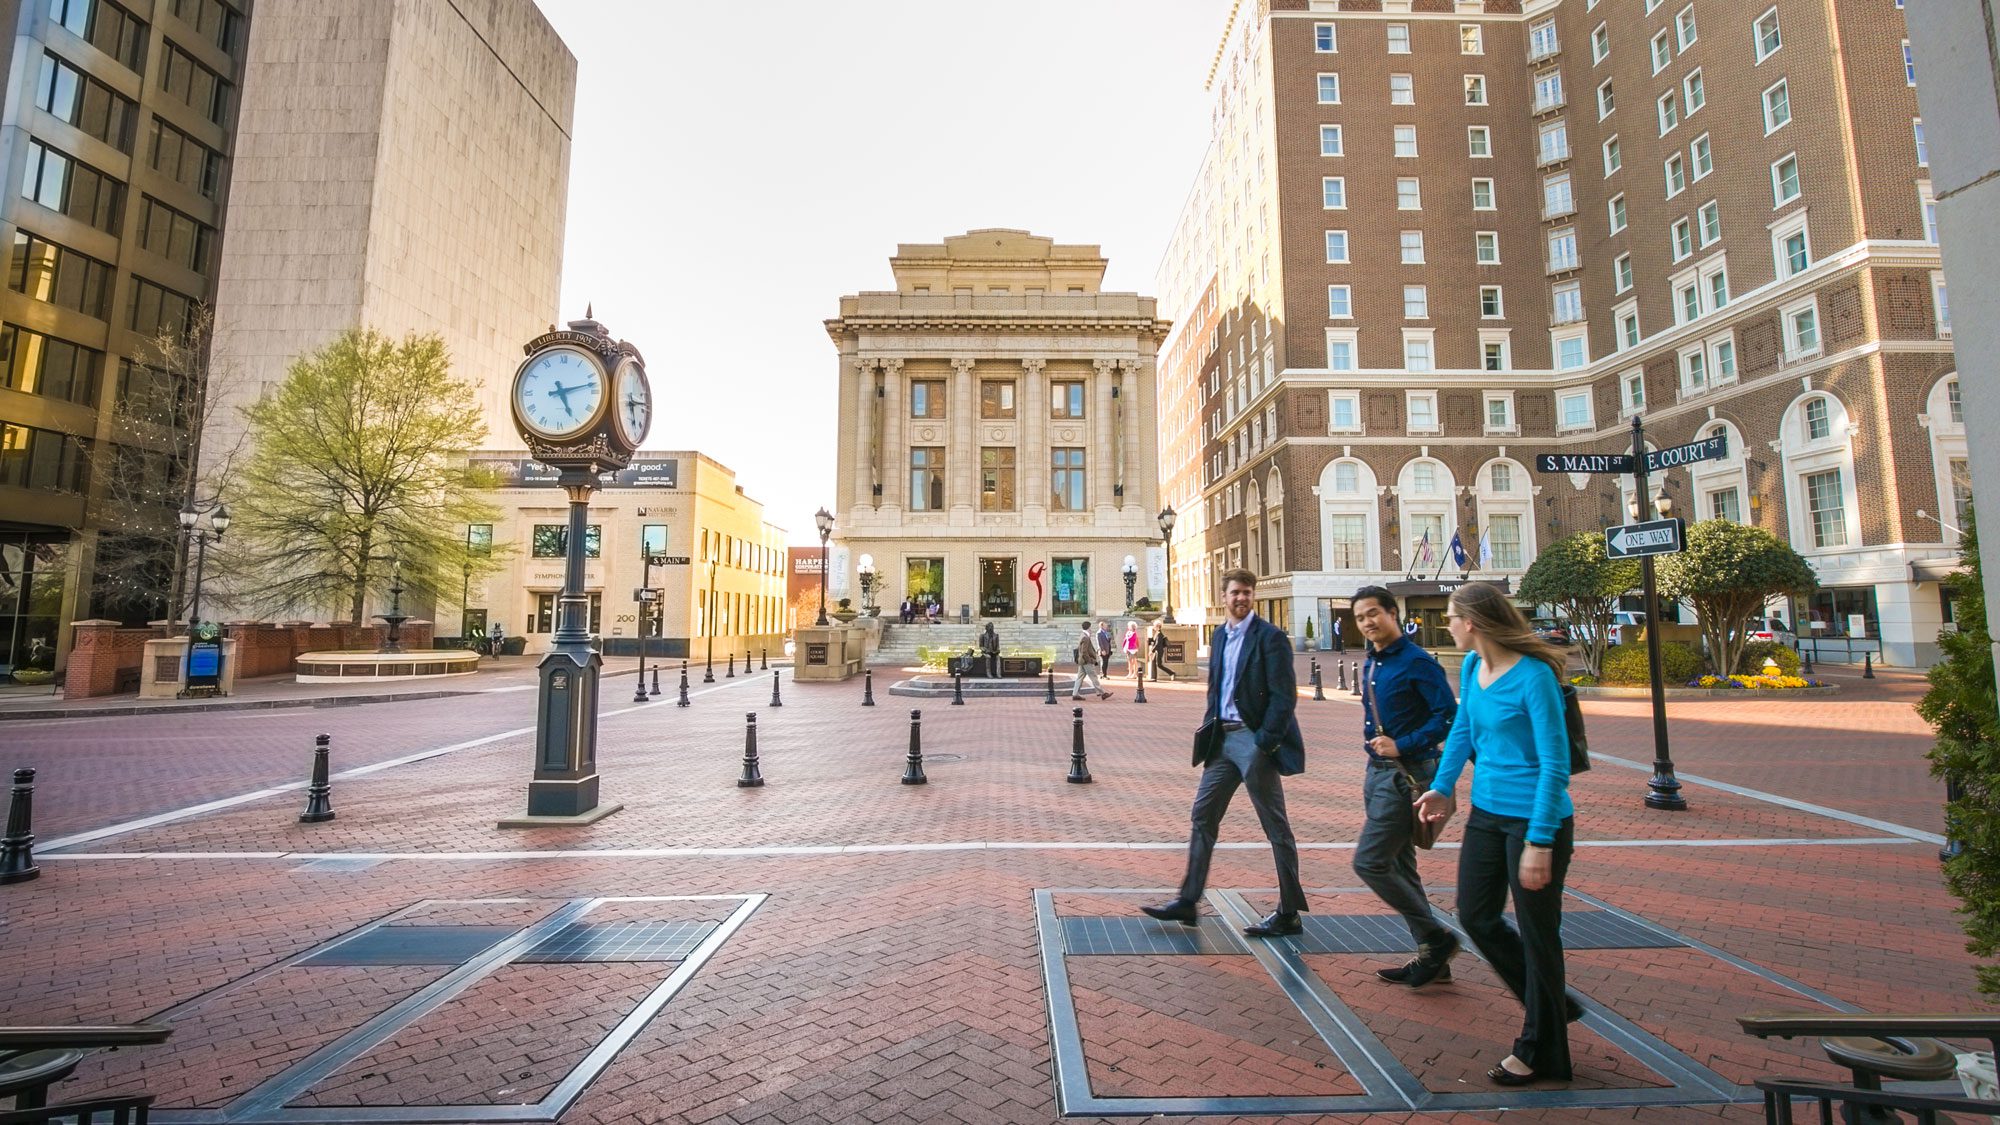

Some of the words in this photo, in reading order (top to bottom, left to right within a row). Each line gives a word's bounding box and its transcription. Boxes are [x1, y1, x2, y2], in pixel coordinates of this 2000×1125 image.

[538, 332, 572, 344] LIBERTY
[576, 334, 592, 344] 1905
[889, 338, 968, 348] GREENVILLE
[1029, 338, 1109, 348] COURTHOUSE
[1648, 455, 1659, 469] E.
[1661, 442, 1707, 467] COURT
[1709, 439, 1719, 449] ST
[1547, 456, 1559, 471] S.
[1563, 456, 1609, 471] MAIN
[1612, 456, 1623, 465] ST
[1625, 534, 1644, 547] ONE
[1650, 530, 1671, 543] WAY
[617, 614, 636, 622] 200
